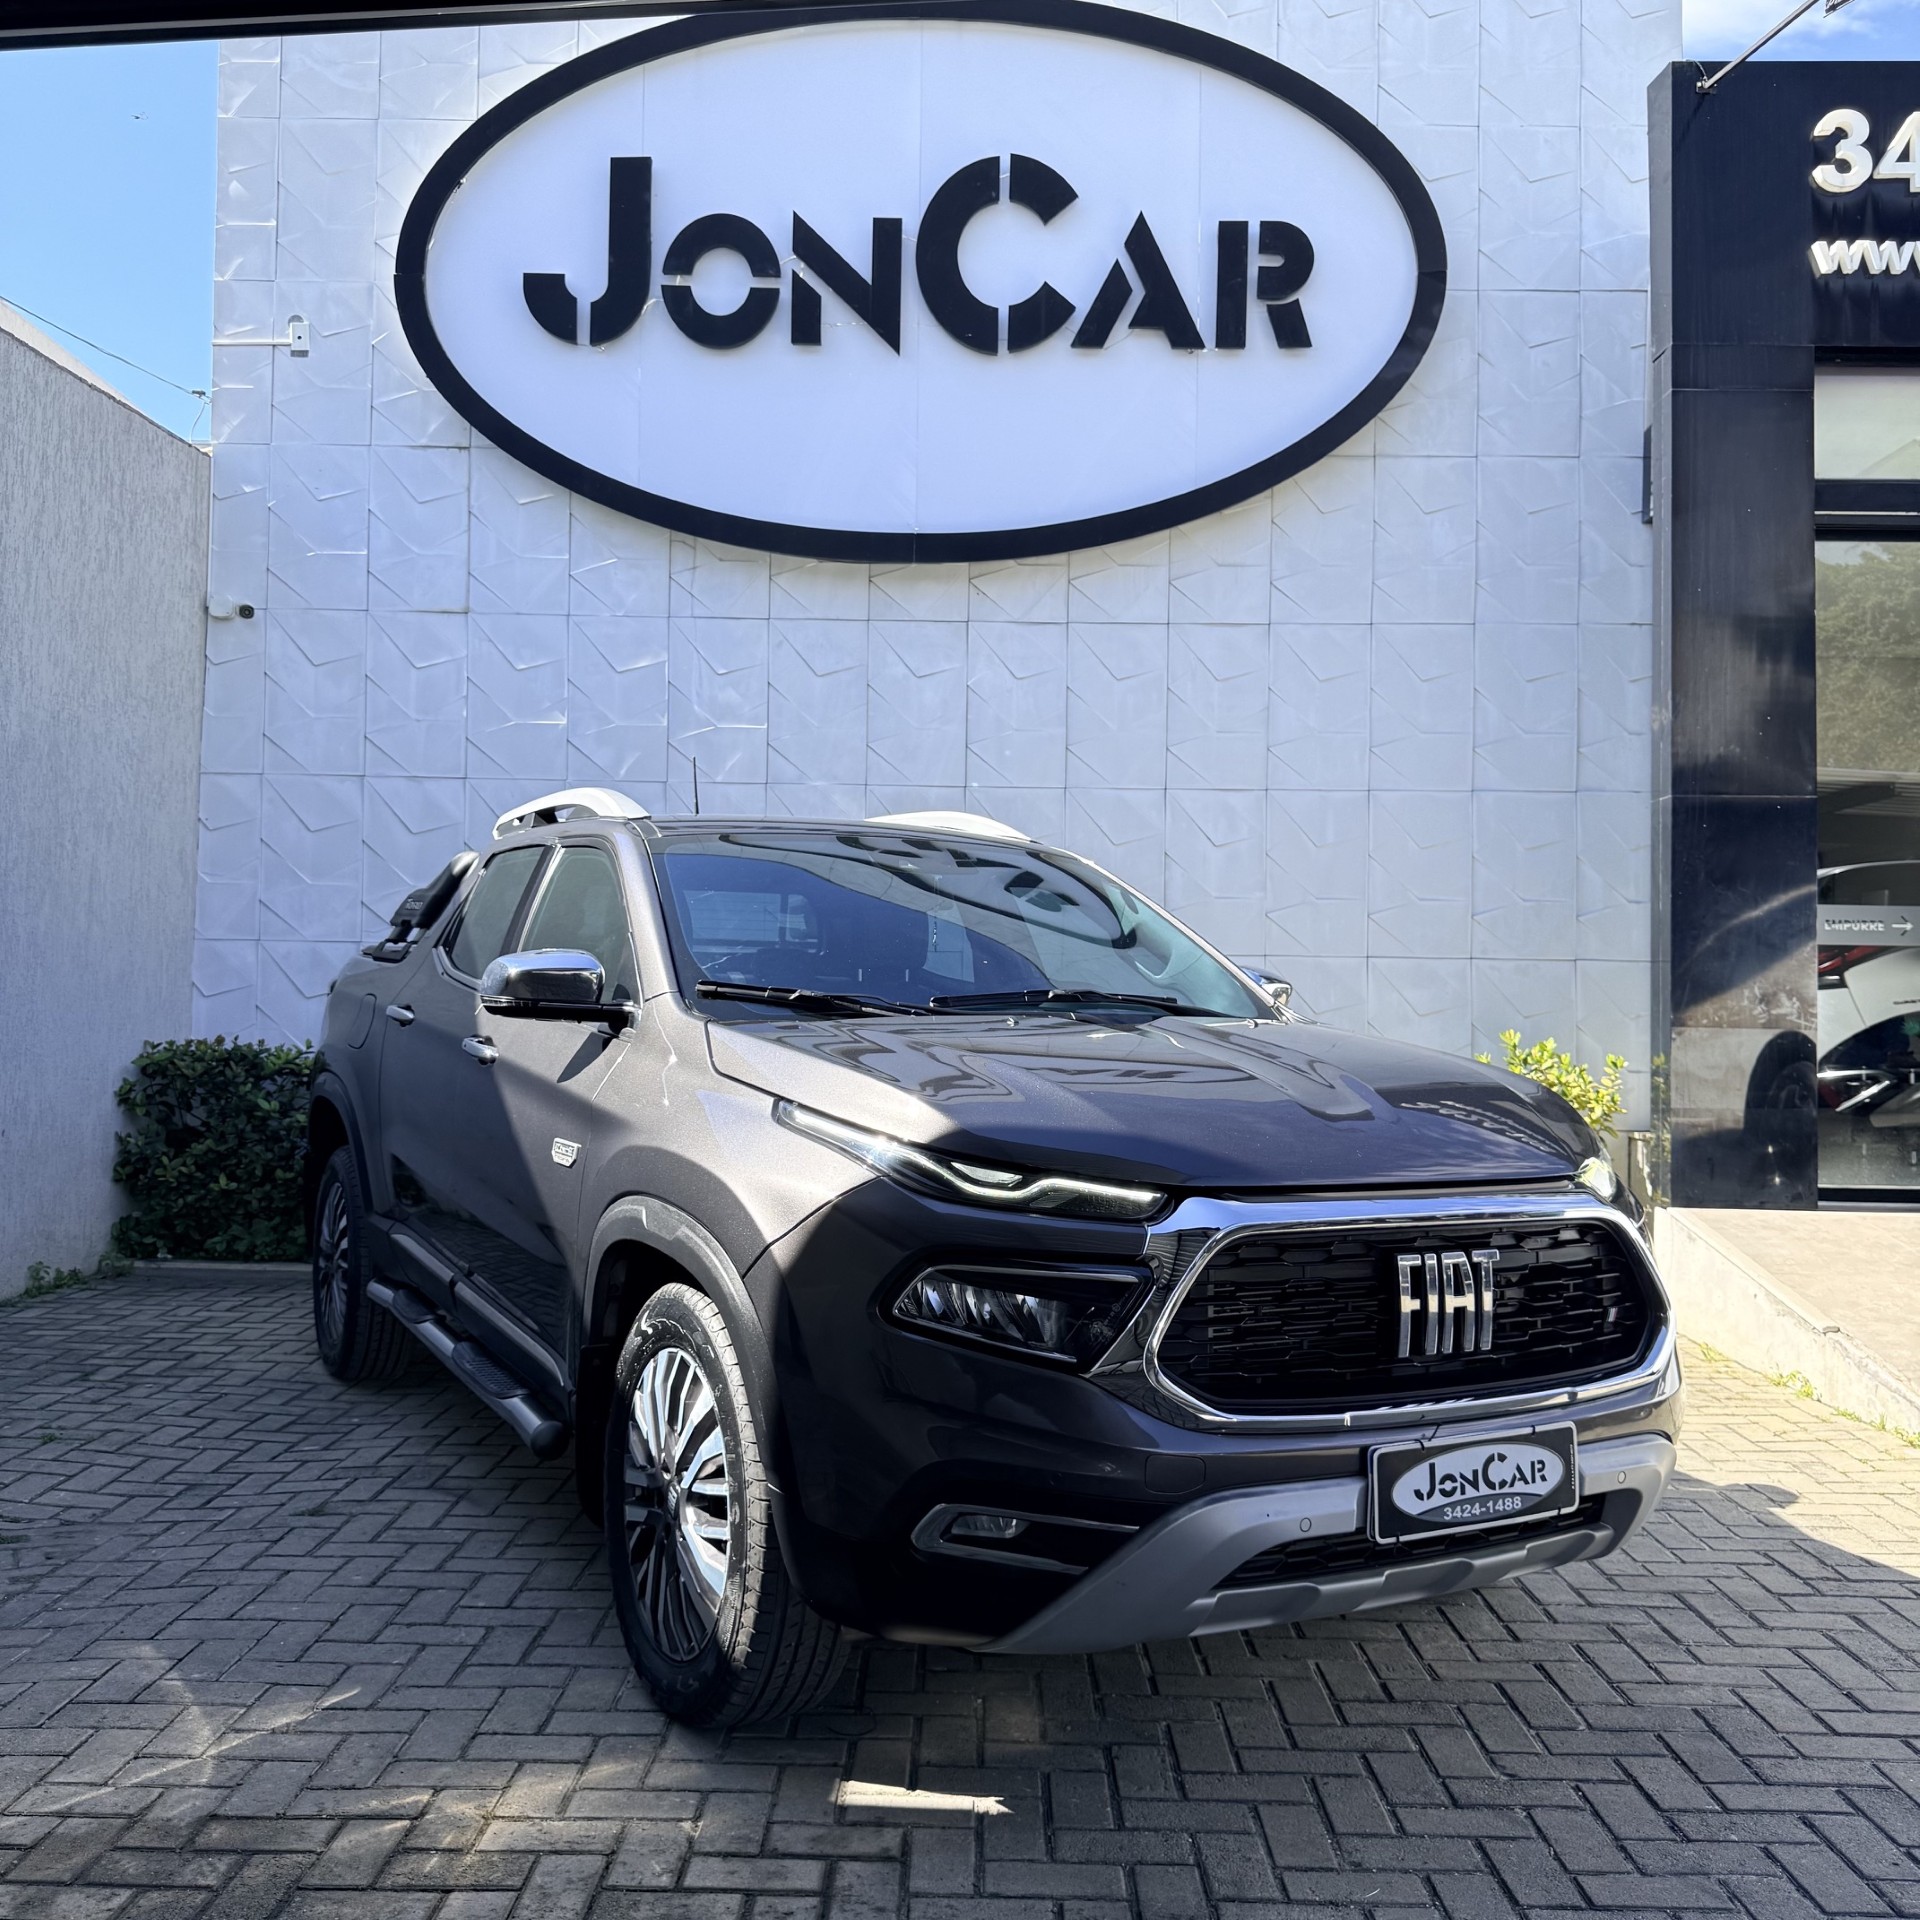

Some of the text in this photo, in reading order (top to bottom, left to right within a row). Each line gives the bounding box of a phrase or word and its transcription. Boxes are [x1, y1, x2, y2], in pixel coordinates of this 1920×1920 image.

[1811, 108, 1920, 193] 34
[1823, 919, 1886, 932] EMPURRE
[1397, 1249, 1500, 1358] FIAT
[1443, 1496, 1523, 1521] 3424-1488
